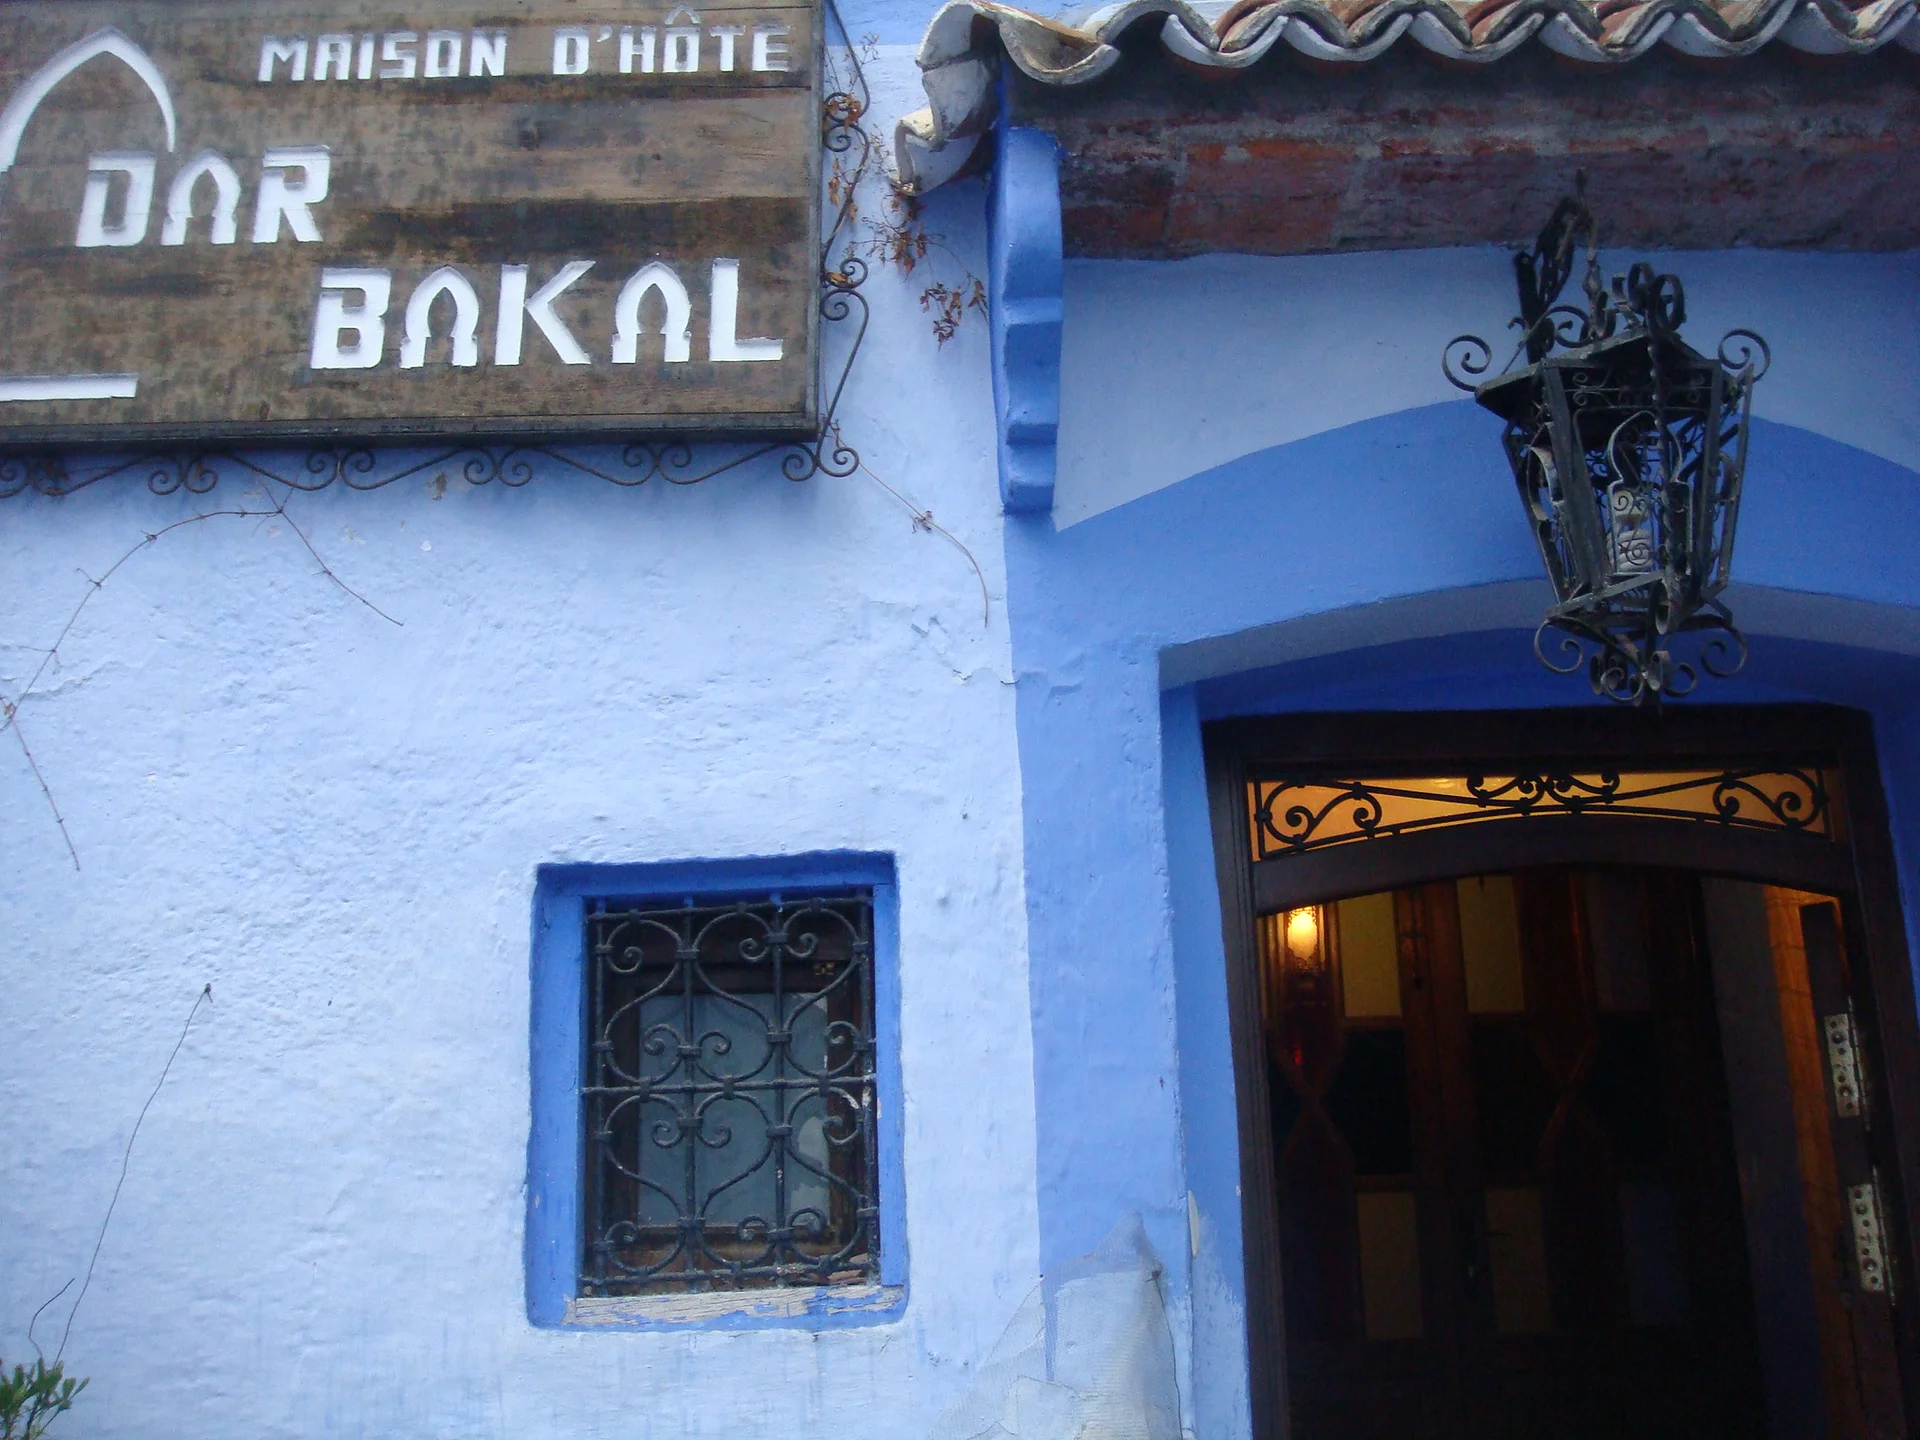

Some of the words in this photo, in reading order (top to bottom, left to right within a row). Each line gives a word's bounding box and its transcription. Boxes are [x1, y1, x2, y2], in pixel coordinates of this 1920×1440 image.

[258, 31, 508, 82] MAISON
[552, 4, 791, 75] D'HÔTE
[75, 144, 331, 248] DAR
[310, 258, 784, 370] BAKAL
